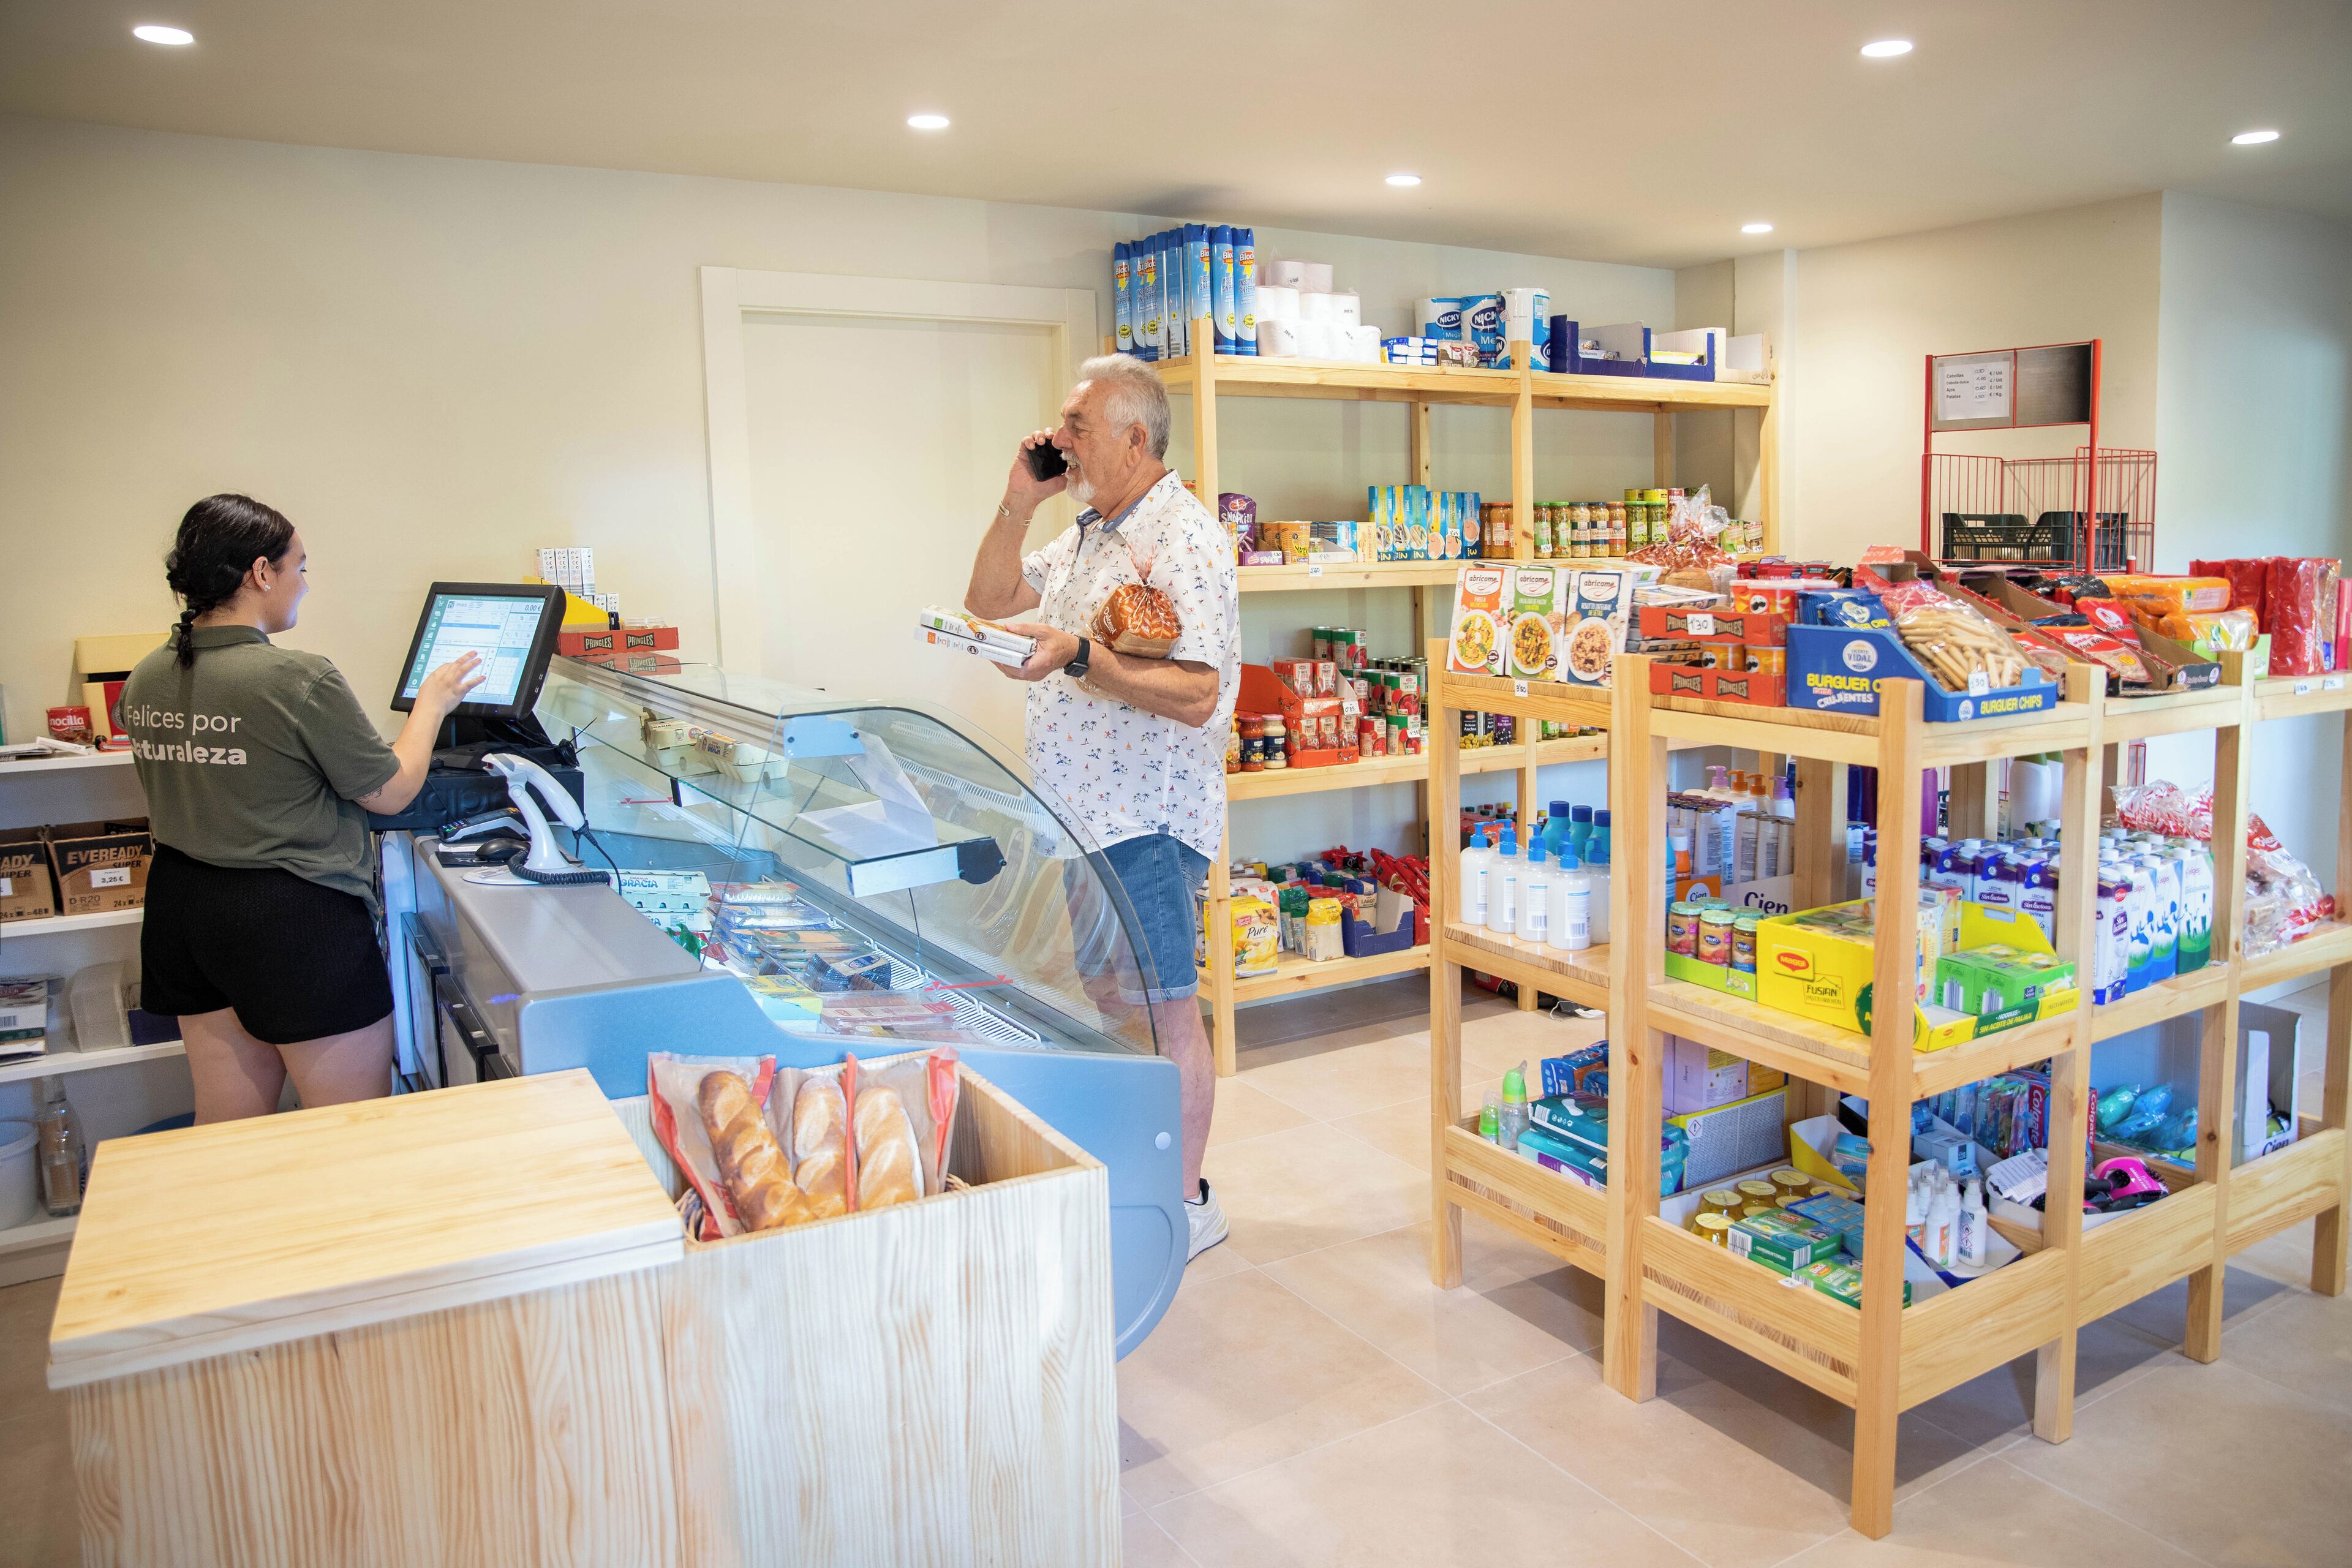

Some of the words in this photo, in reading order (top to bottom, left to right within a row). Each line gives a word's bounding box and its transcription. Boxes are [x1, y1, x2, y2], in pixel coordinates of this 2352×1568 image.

[1439, 312, 1461, 324] NICKY
[1474, 310, 1496, 325] NICK
[1469, 575, 1498, 583] abricome
[1519, 574, 1549, 584] abricome
[1584, 578, 1615, 588] abricome
[1667, 614, 1689, 631] PRINGL
[1689, 618, 1708, 630] 1'30
[1714, 619, 1743, 637] PRINGLES
[585, 636, 612, 650] PRINGLES
[627, 635, 654, 647] PRINGLES
[1847, 653, 1872, 663] VIDAL
[1515, 683, 1527, 692] 3'50
[1673, 674, 1702, 693] PRINGLES
[1717, 679, 1748, 698] PRINGLES
[1806, 673, 1871, 692] BURGUER
[1969, 677, 1985, 688] 1'30
[1980, 697, 2019, 715] BURGUER
[2019, 693, 2043, 710] CHIPS
[49, 714, 85, 726] nocilla
[127, 704, 184, 729] Felices
[192, 714, 242, 736] por
[66, 845, 143, 865] EVEREADY
[620, 878, 658, 888] GRACIA
[1689, 891, 1707, 902] Cien
[1744, 891, 1789, 914] Cien
[2032, 902, 2051, 910] lactosa
[1246, 922, 1270, 939] Puré
[2113, 922, 2127, 933] lactosa
[1779, 954, 1806, 967] Maggi
[1806, 984, 1837, 997] FUSIAN
[1998, 1010, 2018, 1020] NOODLES
[1978, 1024, 1989, 1034] SIN
[1989, 1021, 2007, 1031] ACEITE
[2013, 1013, 2033, 1025] PALMA
[2030, 1088, 2044, 1145] Colgate
[2088, 1093, 2097, 1145] Colgate
[1843, 1165, 1866, 1174] CITRONE
